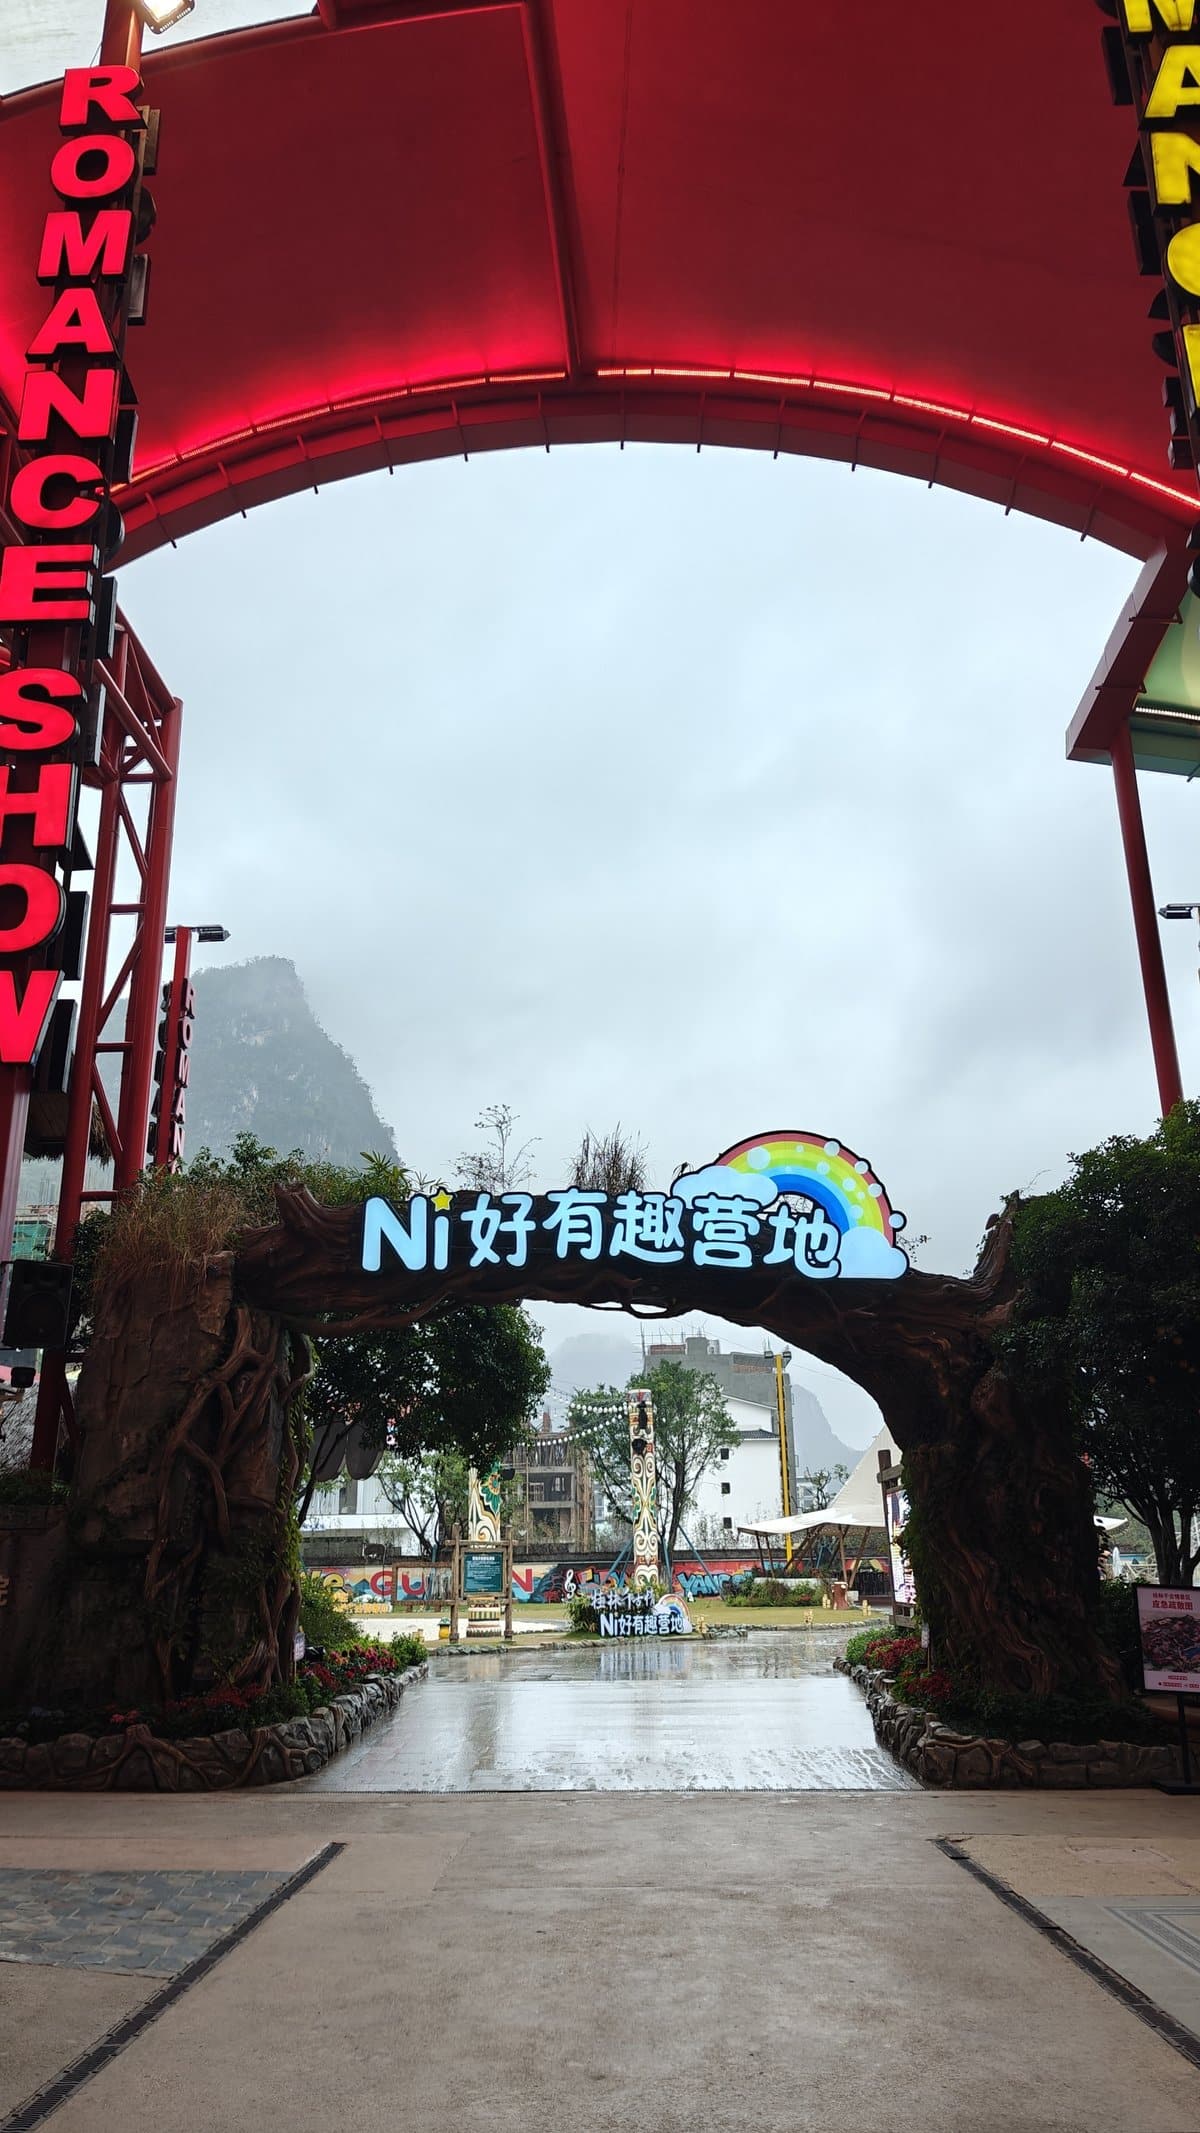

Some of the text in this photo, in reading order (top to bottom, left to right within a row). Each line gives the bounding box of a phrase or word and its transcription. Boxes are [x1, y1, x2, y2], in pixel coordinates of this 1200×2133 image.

[1, 66, 142, 621] ROMANCE
[591, 1586, 656, 1610] 桂林千古情
